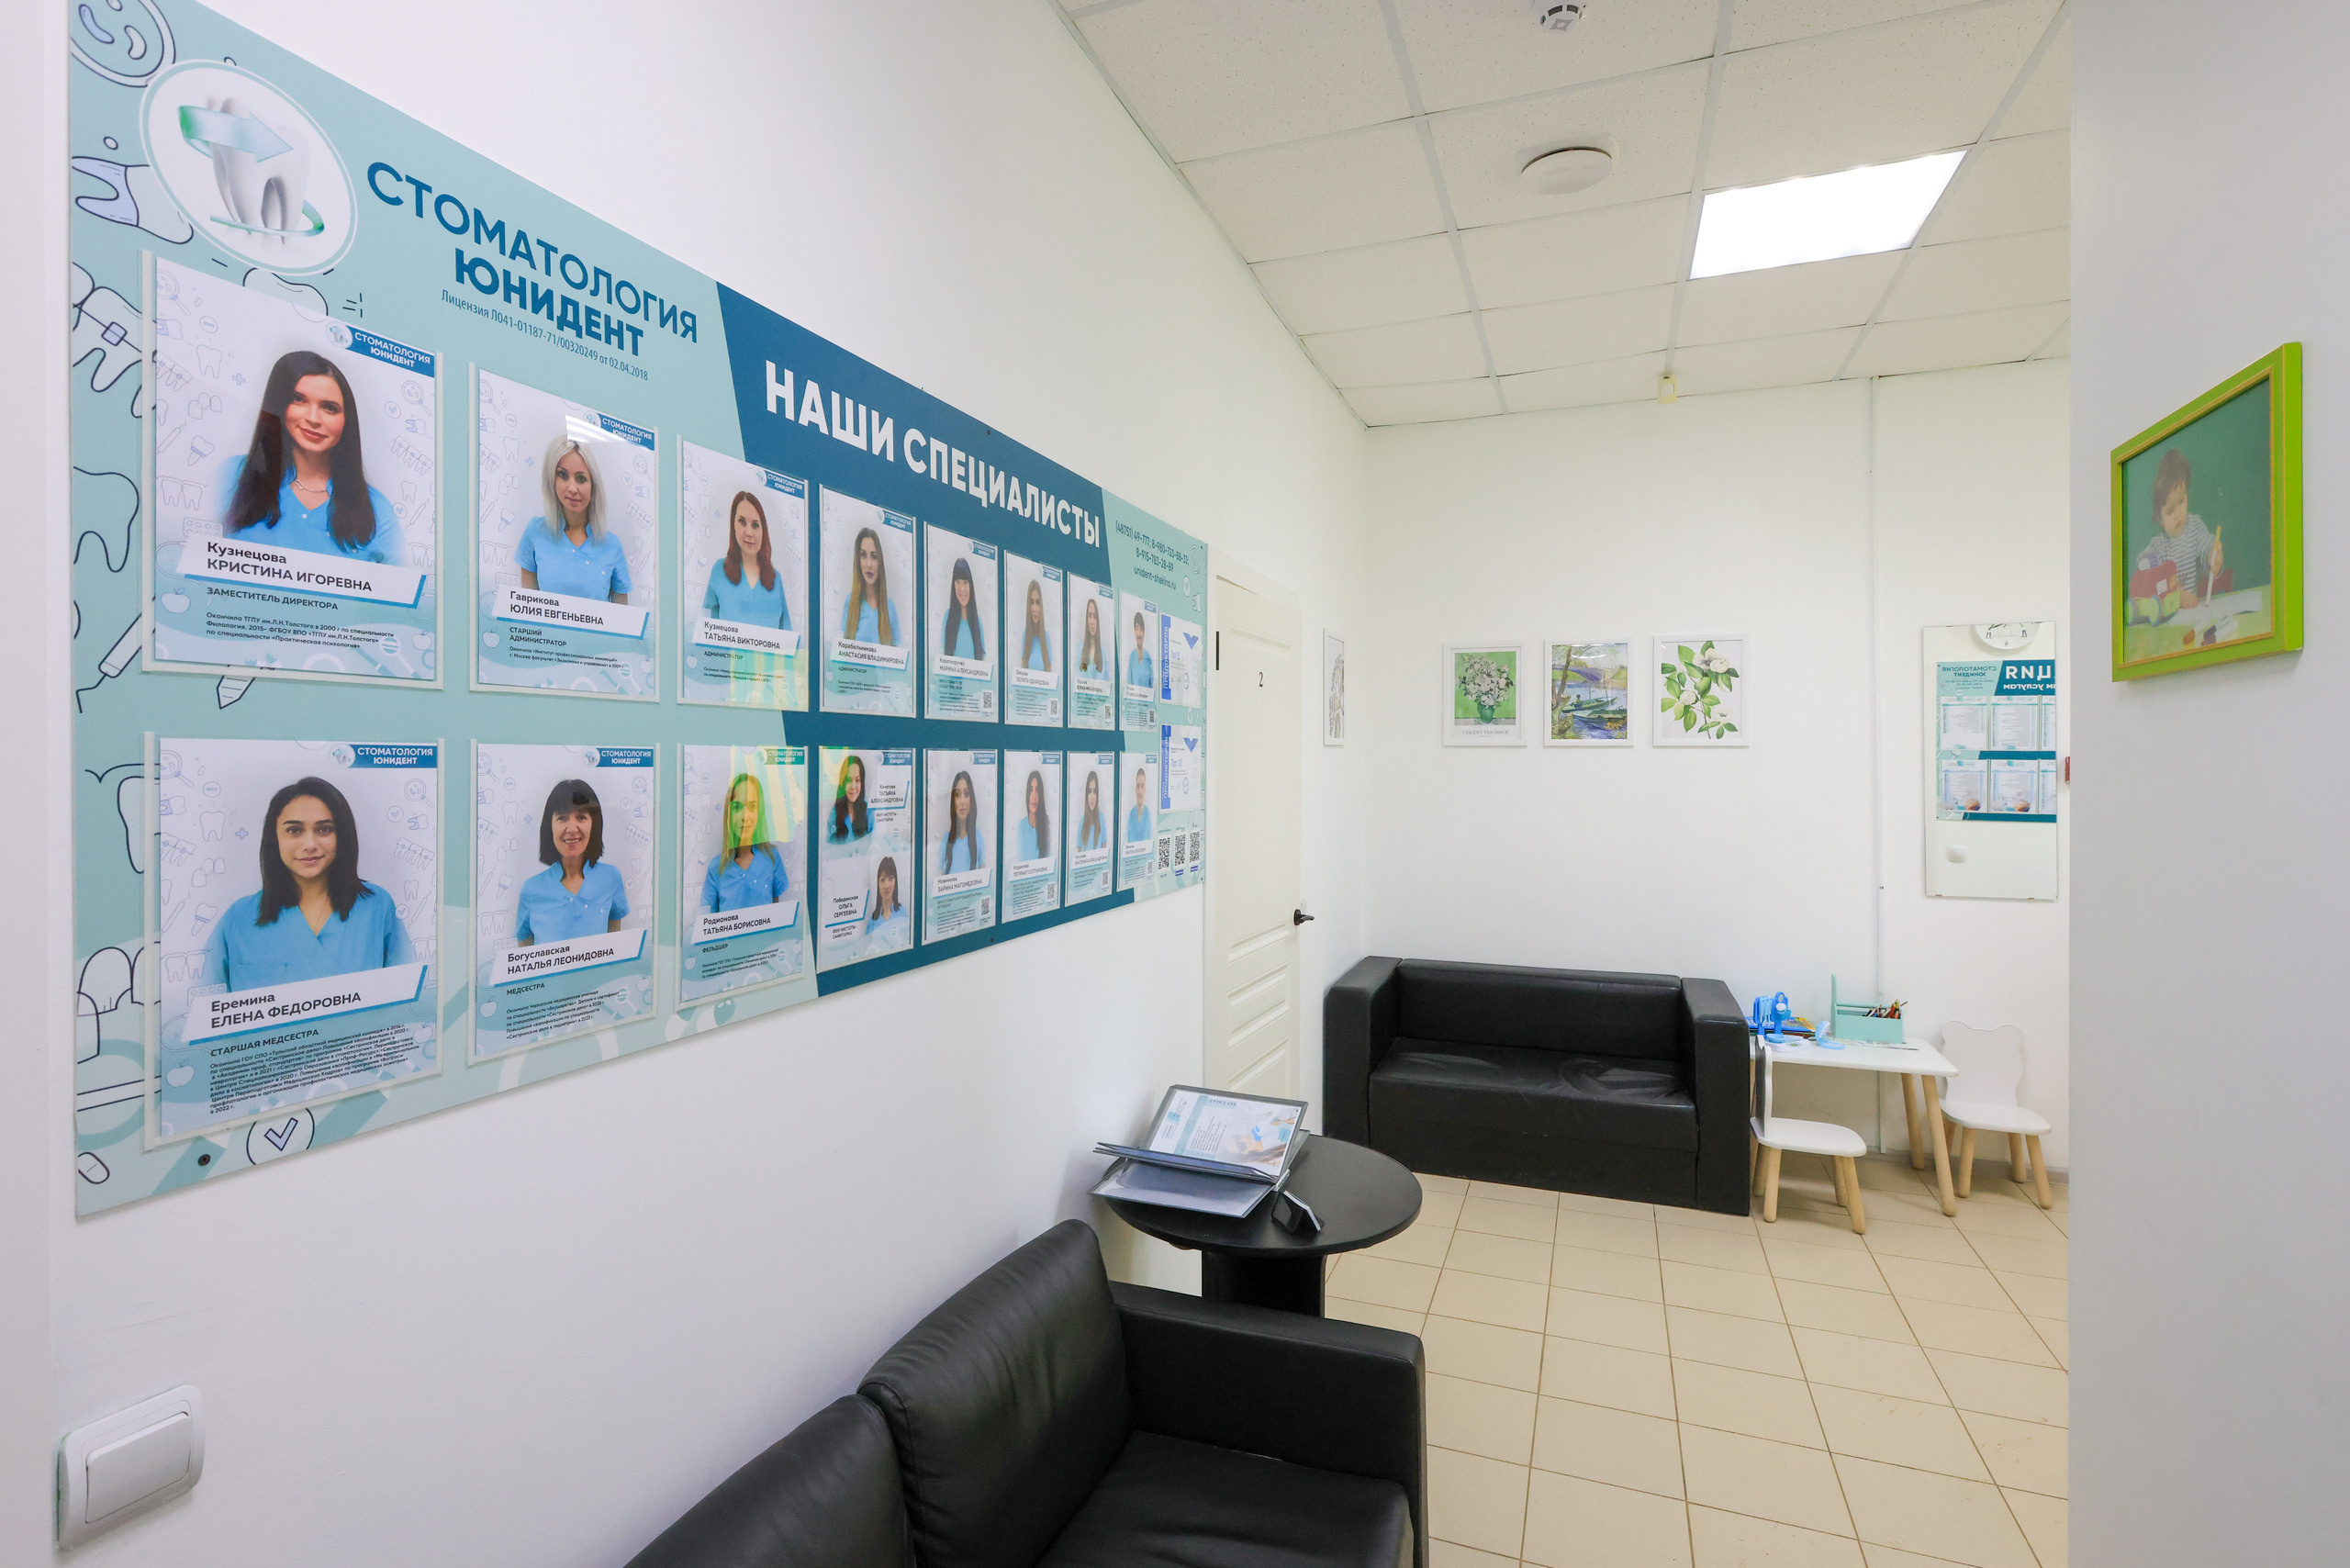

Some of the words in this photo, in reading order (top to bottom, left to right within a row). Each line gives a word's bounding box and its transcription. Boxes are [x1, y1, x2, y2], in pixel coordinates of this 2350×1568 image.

[367, 162, 698, 343] СТОМАТОЛОГИЯ
[455, 247, 643, 357] ЮНИДЕНТ
[442, 289, 497, 319] Лицензия
[491, 308, 598, 361] Л041-01187-71/00320249
[599, 356, 608, 364] от
[609, 357, 648, 381] 02.04.2018
[355, 332, 431, 364] СТОМАТОЛОГИЯ
[371, 347, 415, 367] ЮНИДЕНТ
[602, 418, 653, 441] СТОМАТОЛОГИЯ
[613, 429, 642, 443] ЮНИДЕНТ
[766, 359, 894, 462] НАШИ
[903, 428, 1100, 548] СПЕЦИАЛИСТЫ
[767, 474, 803, 490] СТОМАТОЛОГИЯ
[207, 542, 286, 565] Кузнецова
[207, 558, 293, 581] КРИСТИНА
[297, 571, 373, 593] ИГОРЕВНА
[207, 587, 280, 604] ЗАМЕСТИТЕЛЬ
[282, 597, 339, 610] ДИРЕКТОРА
[510, 590, 560, 607] Гаврикова
[509, 604, 543, 617] ЮЛИЯ
[544, 610, 604, 626] ЕВГЕНЬЕВНА
[206, 611, 241, 621] Окончила
[350, 629, 393, 637] специальности
[509, 627, 543, 636] СТАРШИЙ
[704, 622, 739, 633] Кузнецова
[217, 630, 269, 640] специальности
[272, 634, 320, 644] «Практическая
[509, 635, 567, 647] АДМИНИСТРАТОР
[704, 633, 736, 643] ТАТЬЯНА
[737, 637, 780, 649] ВИКТОРОВНА
[704, 651, 744, 660] АДМИНИСТРАТОР
[838, 651, 867, 659] АНАСТАСИЯ
[1259, 671, 1263, 688] 2
[357, 747, 433, 756] СТОМАТОЛОГИЯ
[374, 757, 418, 766] ЮНИДЕНТ
[703, 915, 739, 925] Родионова
[703, 925, 733, 935] ТАТЬЯНА
[734, 918, 771, 931] БОРИСОВНА
[508, 946, 570, 963] Богуславская
[508, 959, 552, 975] НАТАЛЬЯ
[554, 948, 615, 967] ЛЕОНИДОВНА
[507, 982, 545, 995] МЕДСЕСТРА
[211, 993, 275, 1013] Еремина
[211, 1010, 264, 1029] ЕЛЕНА
[268, 992, 362, 1019] ФЕДОРОВНА
[209, 1058, 240, 1068] Окончила
[327, 1033, 360, 1043] медицинский
[211, 1041, 261, 1057] СТАРШАЯ
[263, 1029, 319, 1047] МЕДСЕСТРА
[284, 1072, 319, 1084] Медицинских
[215, 1104, 229, 1113] 2022
